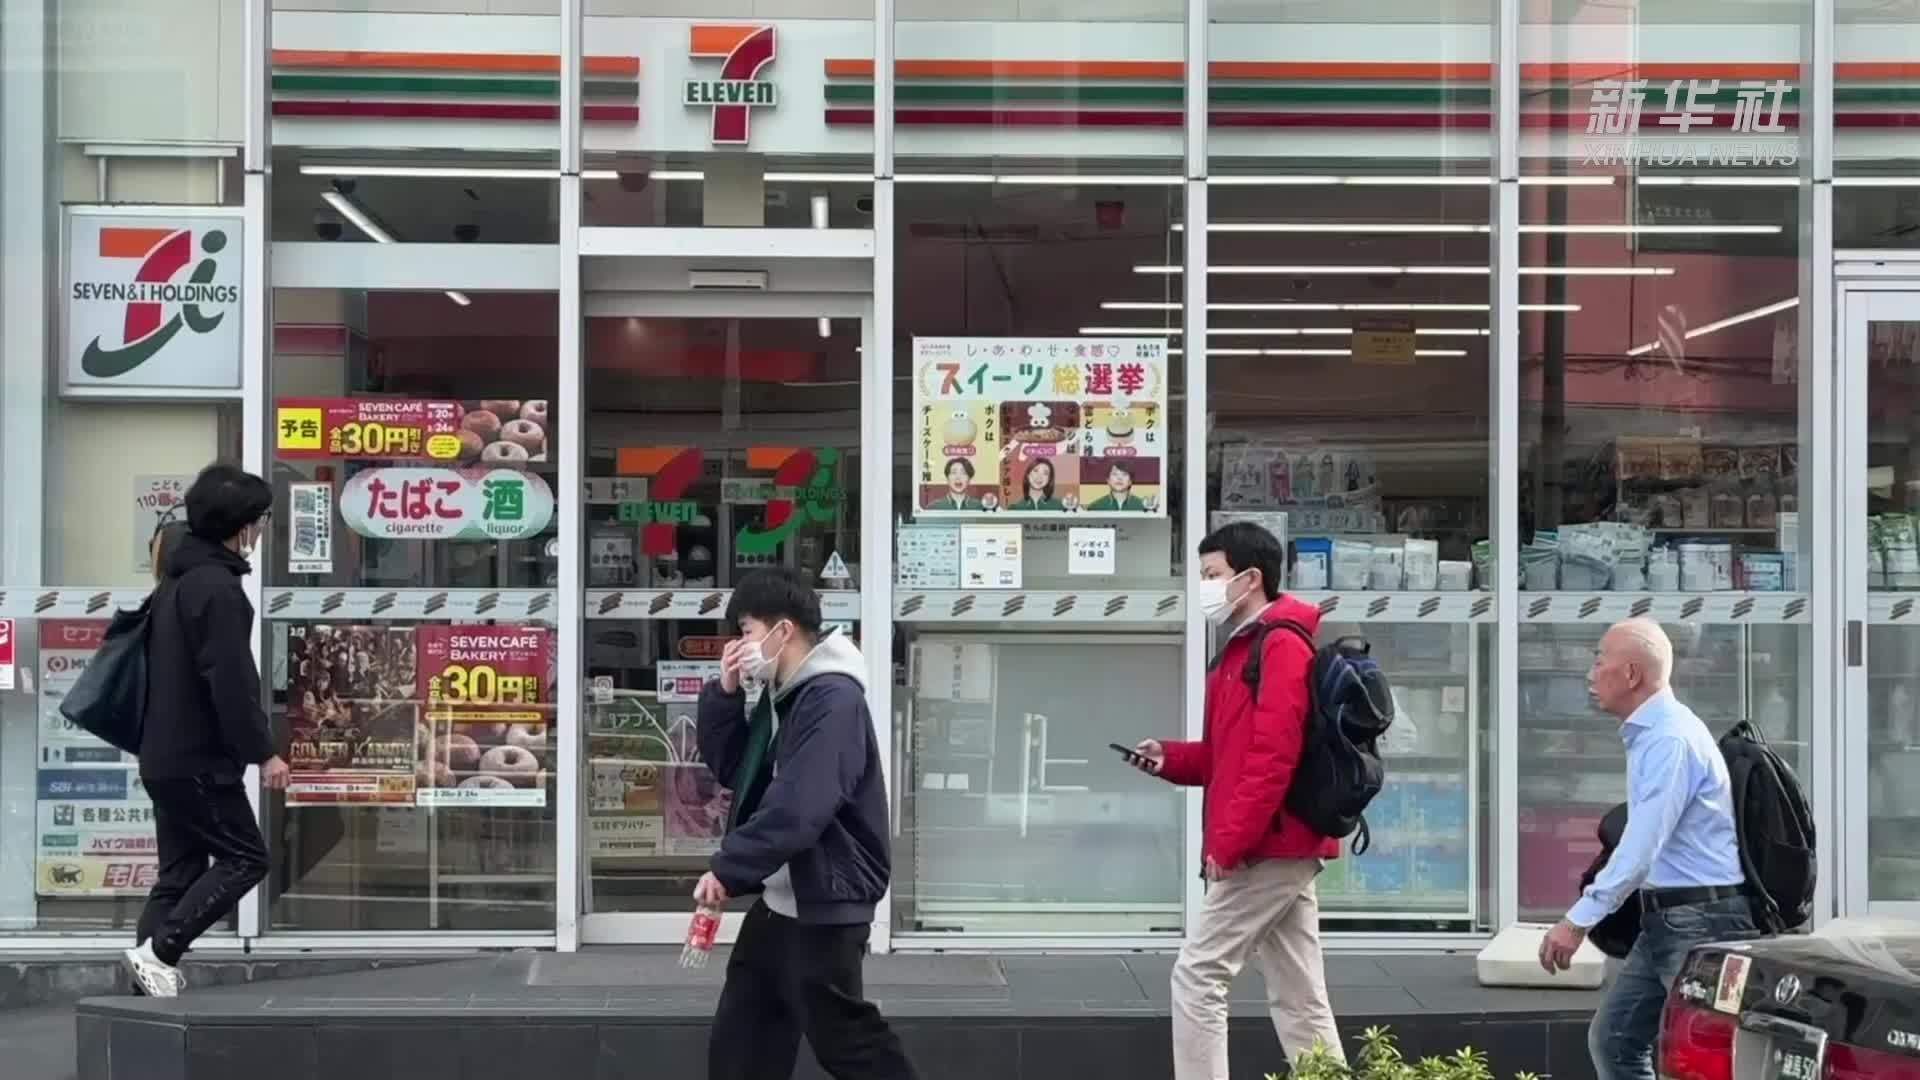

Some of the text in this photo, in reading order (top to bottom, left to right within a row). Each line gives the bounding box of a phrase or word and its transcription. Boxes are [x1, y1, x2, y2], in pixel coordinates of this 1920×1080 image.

[151, 283, 238, 303] HOLDINGS
[358, 403, 395, 413] SEVEN
[396, 401, 423, 413] CAFÉ
[358, 412, 399, 422] BAKERY
[280, 419, 319, 439] 予告
[367, 477, 524, 520] たばこ 酒
[385, 521, 524, 535] cigarette liquor
[450, 635, 499, 649] SEVEN
[500, 633, 538, 649] CAFÉ
[450, 650, 507, 661] BAKERY
